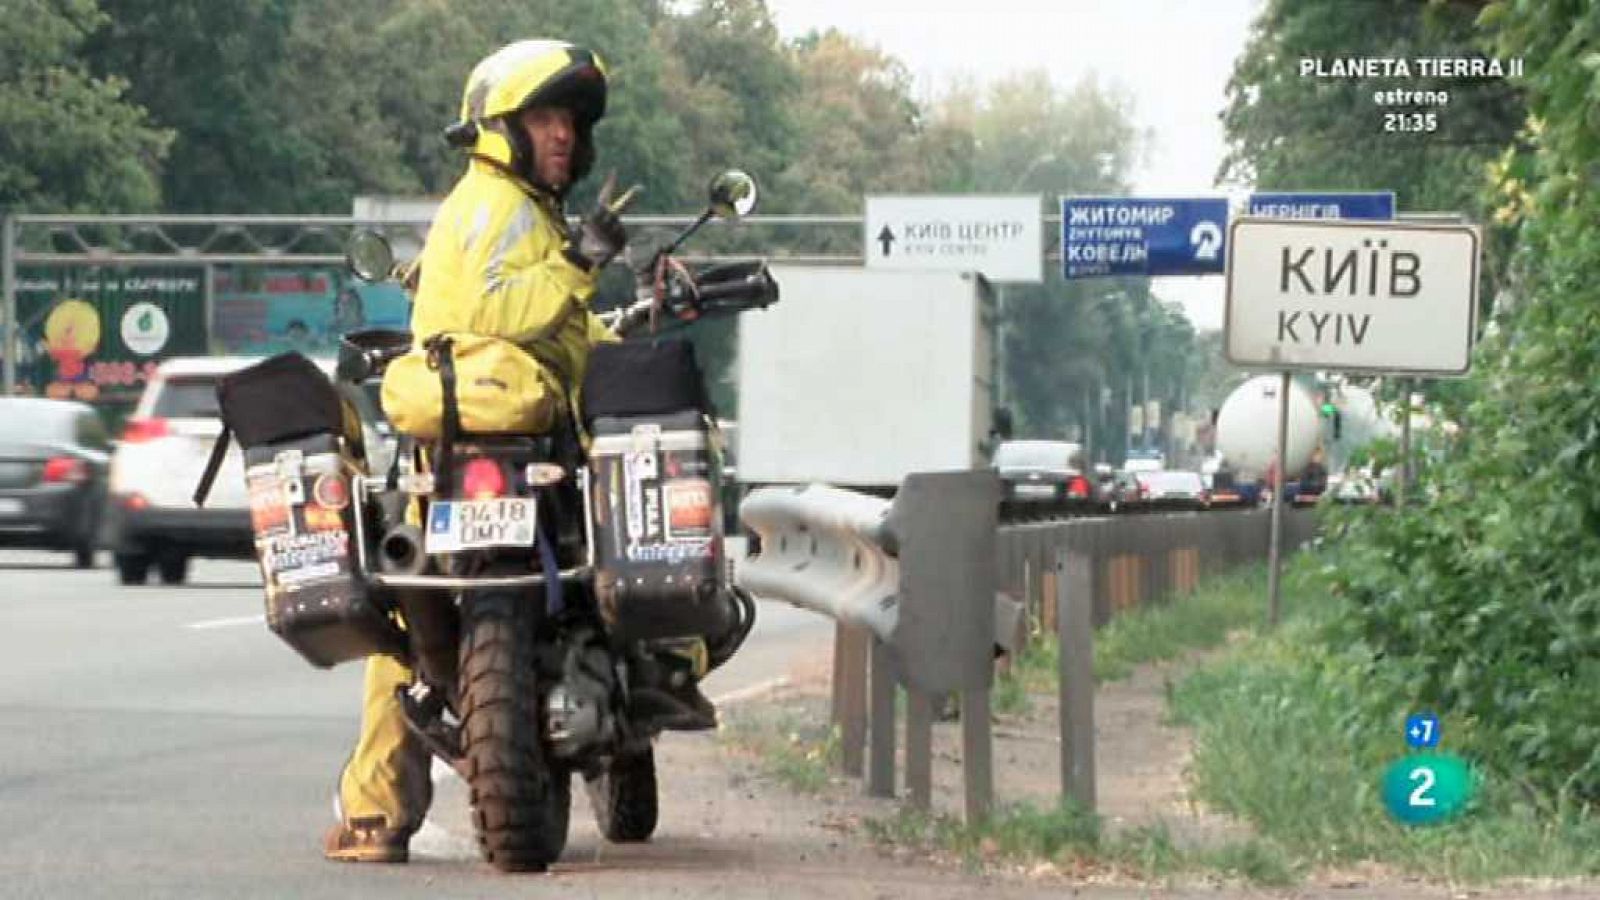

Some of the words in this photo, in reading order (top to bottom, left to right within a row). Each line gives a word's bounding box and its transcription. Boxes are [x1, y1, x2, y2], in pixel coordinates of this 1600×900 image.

[1069, 206, 1174, 225] ЖИТОМИР
[958, 223, 1024, 242] ЦЕНТР
[1280, 239, 1422, 298] КИЇВ
[1278, 310, 1371, 345] KYIV
